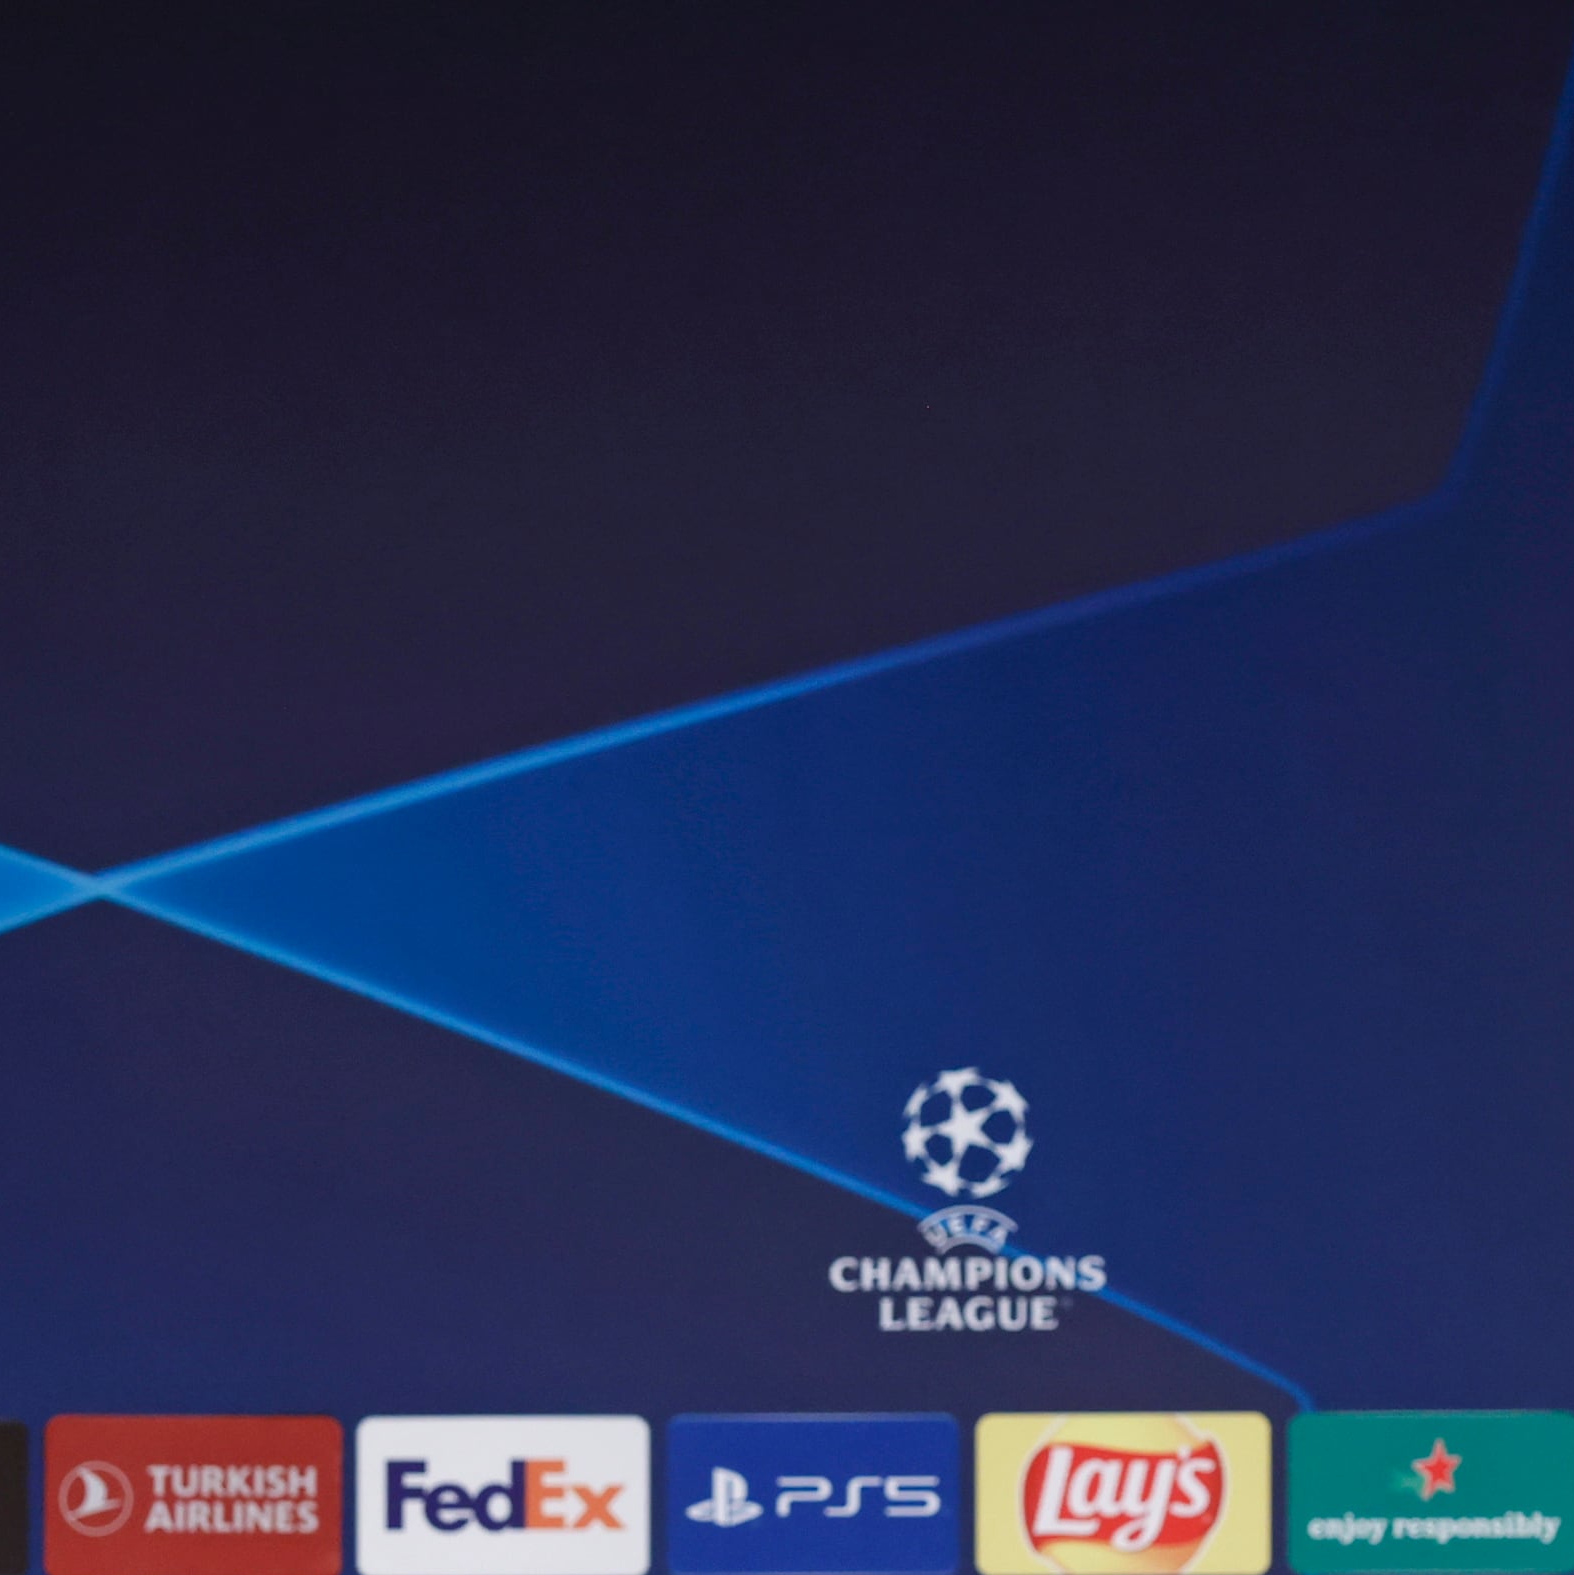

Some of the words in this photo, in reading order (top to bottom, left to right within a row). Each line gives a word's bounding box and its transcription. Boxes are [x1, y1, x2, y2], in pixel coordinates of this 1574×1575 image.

[829, 1255, 1107, 1292] CHAMPIONS
[880, 1296, 1058, 1331] LEAGUE
[148, 1465, 317, 1501] TURKISH
[386, 1459, 624, 1531] FedEx
[776, 1476, 940, 1517] PS5
[1034, 1445, 1215, 1553] Lay's
[145, 1500, 319, 1533] AIRLINES
[1307, 1512, 1388, 1545] enjoy
[1392, 1511, 1561, 1544] responsibly
